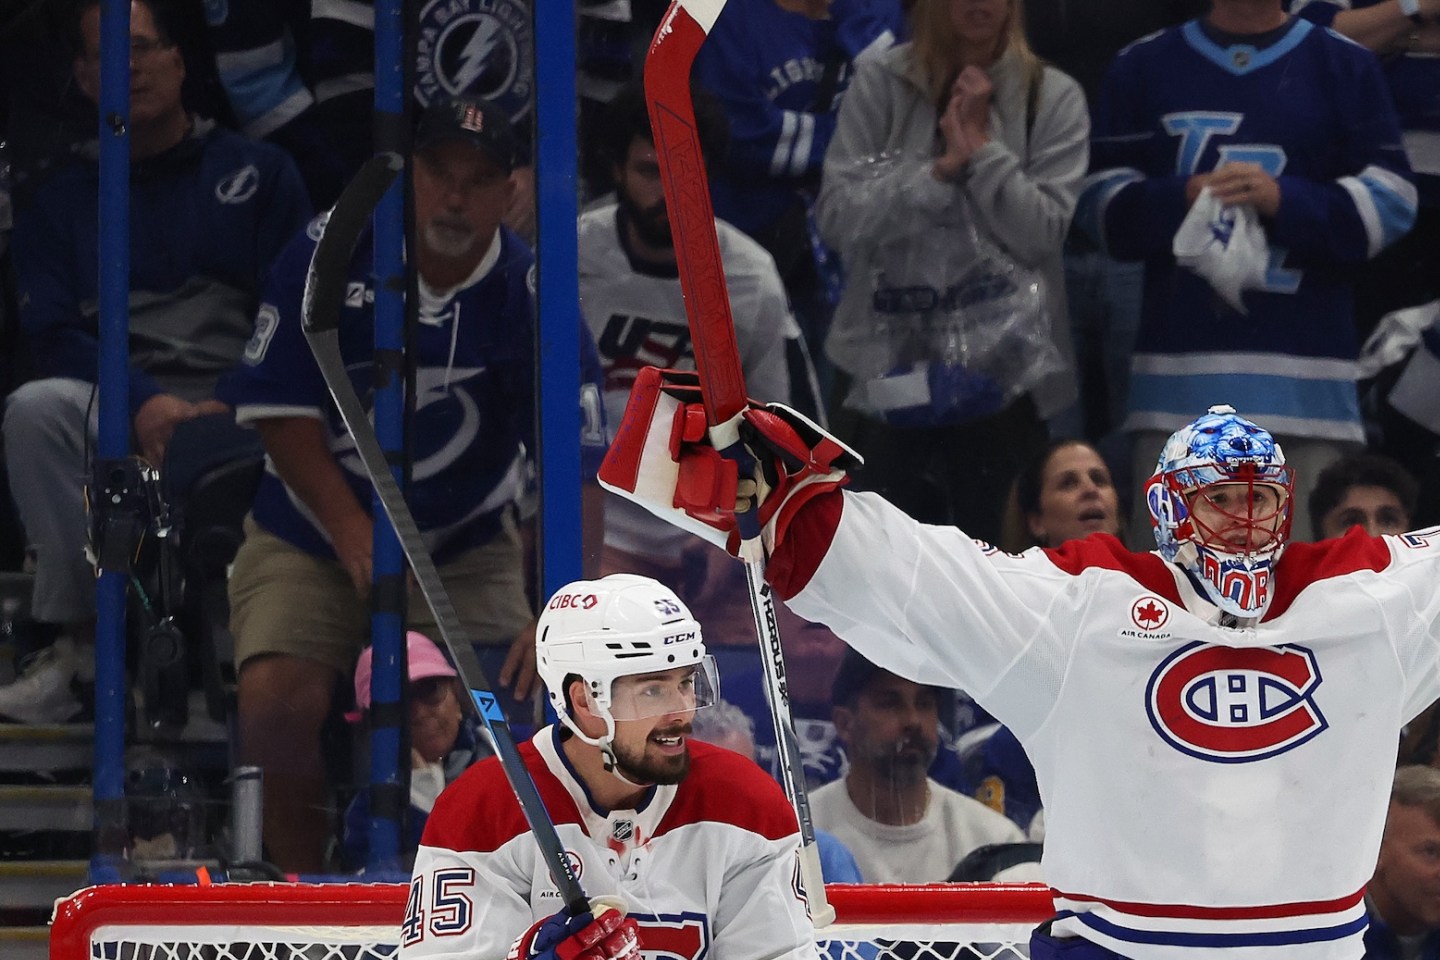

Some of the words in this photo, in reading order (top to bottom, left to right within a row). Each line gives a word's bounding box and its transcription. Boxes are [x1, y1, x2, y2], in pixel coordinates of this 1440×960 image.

[549, 594, 582, 611] CIBC
[663, 631, 696, 646] CCM
[762, 599, 785, 681] HZRDUS
[1121, 630, 1137, 638] AIR
[1137, 632, 1172, 640] CANADA
[557, 851, 574, 882] ALPHA
[540, 890, 556, 898] AIR
[400, 867, 476, 949] 45
